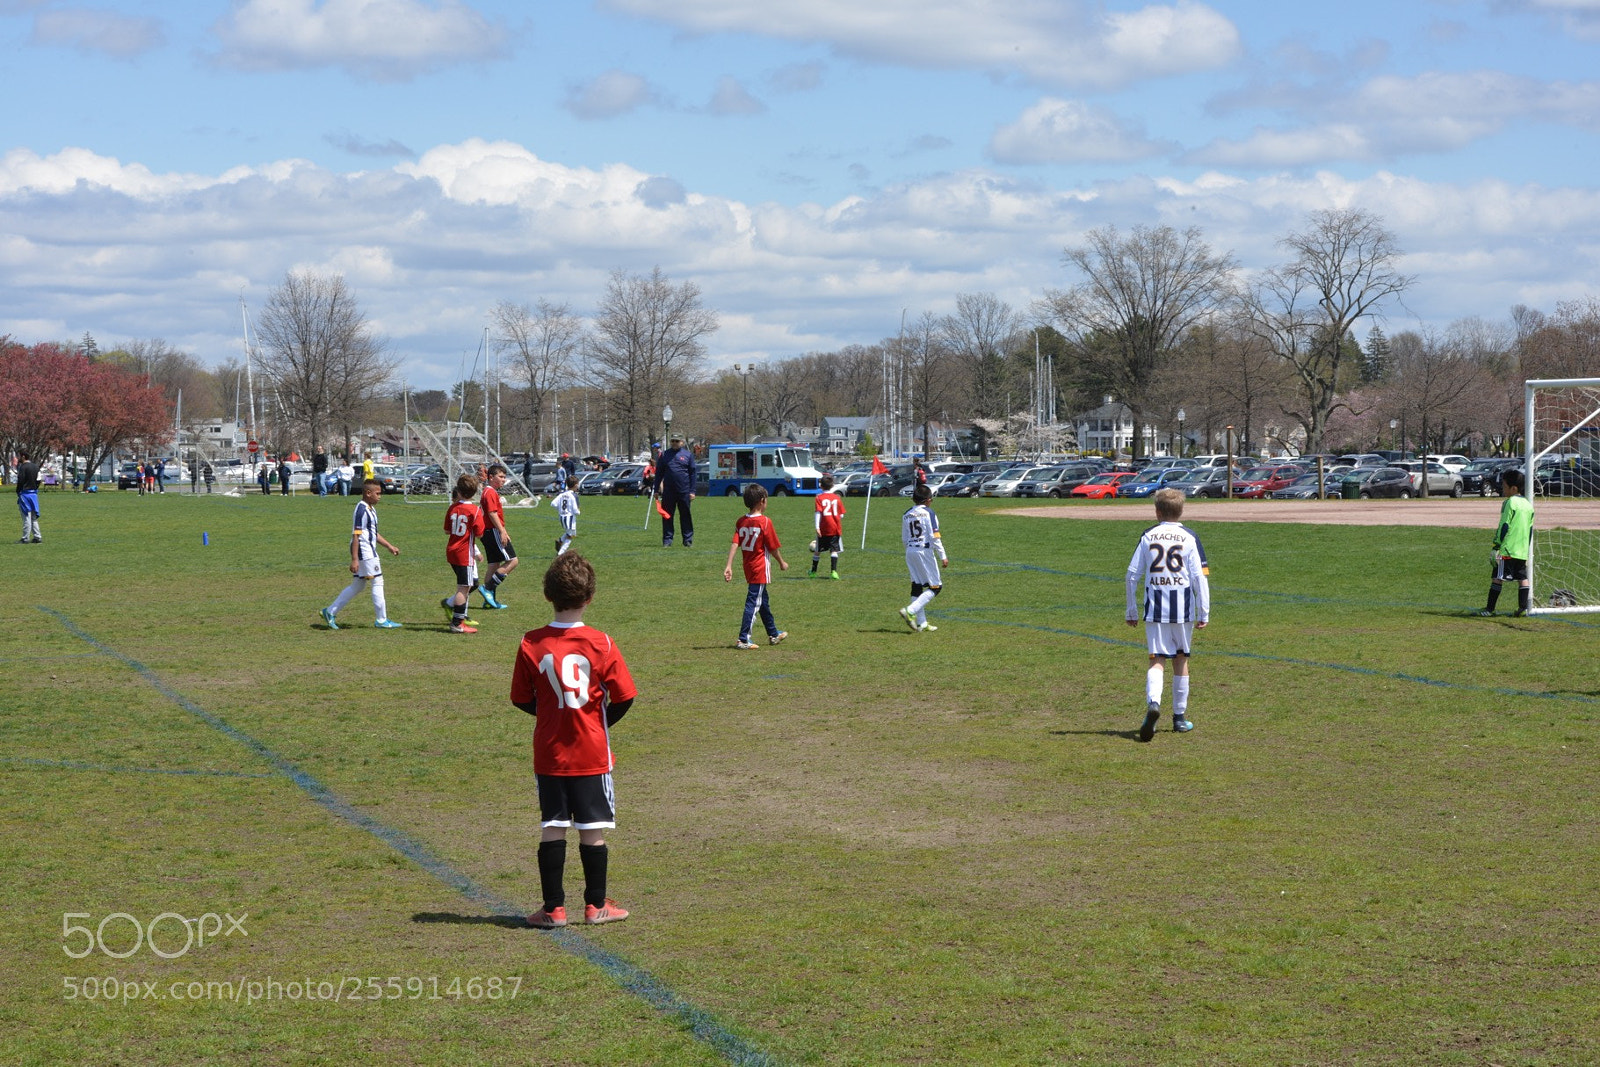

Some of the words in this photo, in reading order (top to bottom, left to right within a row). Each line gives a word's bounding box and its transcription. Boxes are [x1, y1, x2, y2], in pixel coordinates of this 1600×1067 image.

[562, 499, 567, 510] 8
[822, 499, 838, 516] 21
[450, 513, 468, 536] 16
[909, 520, 923, 538] 15
[739, 526, 761, 551] 27
[1150, 533, 1187, 543] TKACHEV
[1149, 543, 1184, 574] 26
[1149, 576, 1172, 586] ALBA
[1173, 576, 1184, 586] FC
[538, 653, 591, 709] 19
